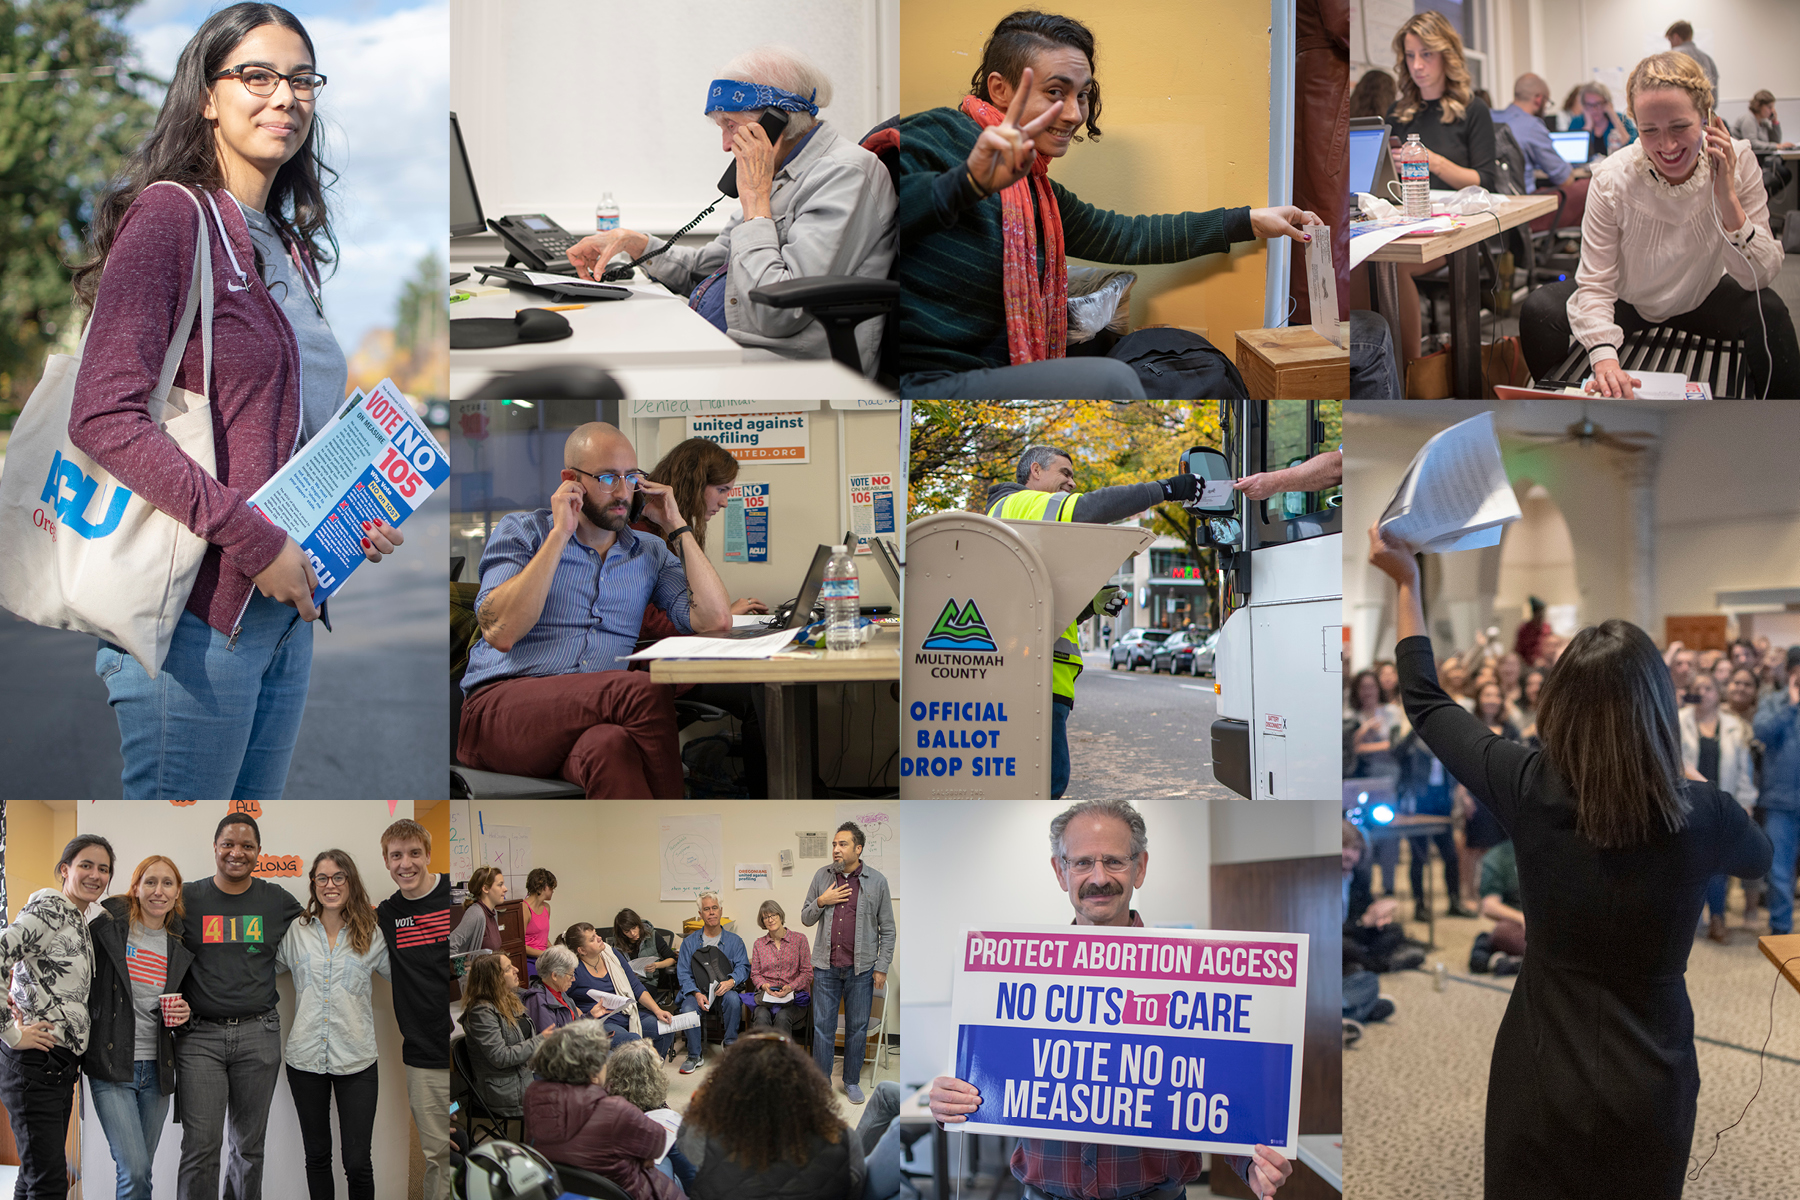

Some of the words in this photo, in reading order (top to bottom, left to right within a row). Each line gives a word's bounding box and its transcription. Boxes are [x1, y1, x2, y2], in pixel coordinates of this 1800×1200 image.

[634, 400, 691, 414] Denied
[356, 412, 365, 421] ON
[363, 419, 385, 444] MEASURE
[365, 389, 403, 435] VOTE
[393, 424, 435, 471] NO
[693, 418, 742, 431] united
[747, 416, 804, 432] against
[731, 449, 797, 458] NITED.ORG
[378, 447, 423, 497] 105
[368, 469, 381, 483] Why
[379, 481, 392, 496] Vote
[850, 477, 869, 487] VOTE
[872, 476, 891, 486] NO
[744, 485, 762, 496] NO
[851, 492, 871, 504] 106
[369, 482, 380, 495] NO
[377, 493, 387, 504] on
[384, 502, 398, 519] 105?
[745, 496, 765, 507] 105
[915, 653, 1004, 667] MULTNOMAH
[931, 667, 987, 679] COUNTY
[910, 701, 1008, 721] OFFICIAL
[917, 729, 1000, 749] BALLOT
[901, 756, 963, 777] DROP
[972, 756, 1016, 777] SITE
[236, 800, 258, 813] ALL
[252, 860, 297, 872] ELONG
[395, 916, 415, 928] VOTE
[126, 945, 136, 957] TE
[969, 937, 1069, 968] PROTECT
[1073, 941, 1192, 974] ABORTION
[1198, 946, 1294, 980] ACCESS
[996, 981, 1037, 1021] NO
[1045, 984, 1123, 1026] CUTS
[1134, 996, 1158, 1022] TO
[1168, 990, 1253, 1034] CARE
[1032, 1038, 1110, 1082] VOTE
[1119, 1043, 1164, 1086] NO
[1171, 1056, 1206, 1089] ON
[1002, 1078, 1155, 1129] MEASURE
[1168, 1091, 1230, 1134] 106
